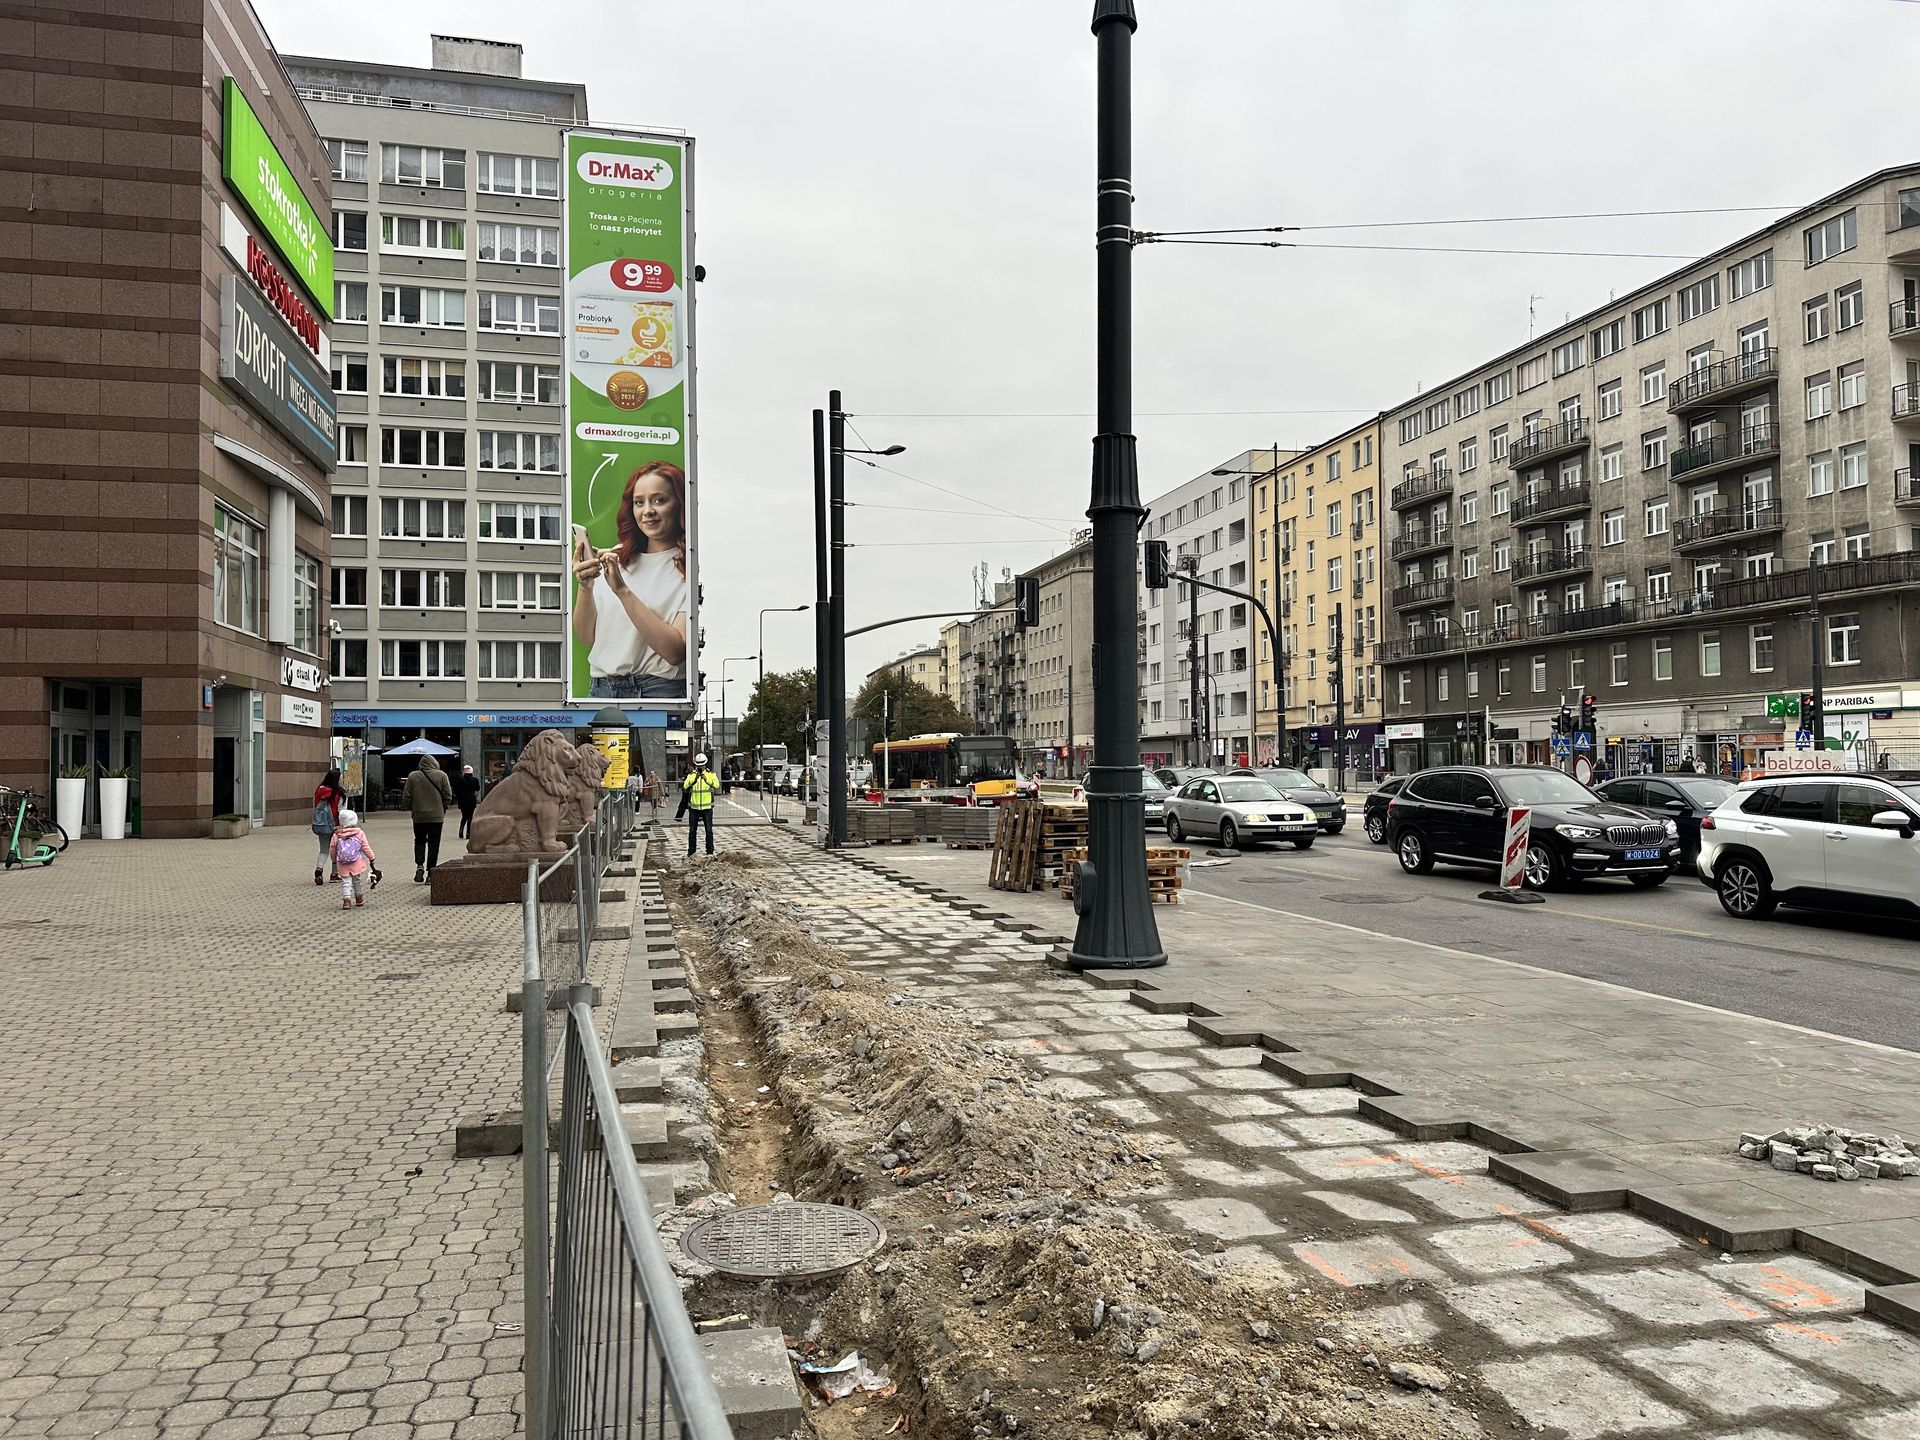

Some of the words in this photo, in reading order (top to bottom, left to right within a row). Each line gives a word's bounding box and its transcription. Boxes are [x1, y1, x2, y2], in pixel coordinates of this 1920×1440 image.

[588, 186, 662, 200] drogeria
[258, 155, 308, 250] stokrotka
[589, 211, 618, 221] Troska
[627, 215, 662, 226] Pacjenta
[589, 223, 599, 231] to
[600, 224, 621, 232] nasz
[623, 227, 662, 236] priorytet
[623, 263, 643, 287] 9
[644, 264, 662, 275] 99
[247, 235, 320, 355] ROSSMANN
[578, 313, 613, 324] Probiotyk
[235, 302, 287, 401] ZDROFIT
[289, 374, 308, 414] WIĘCEJ
[308, 393, 317, 423] NIŻ
[317, 404, 334, 441] FITNESS
[584, 426, 671, 441] drmaxdrogeria.pl
[1822, 699, 1833, 707] NP
[1834, 696, 1875, 706] PARIBAS
[1665, 755, 1674, 766] 24
[1674, 755, 1679, 765] H
[1767, 757, 1832, 771] balzola
